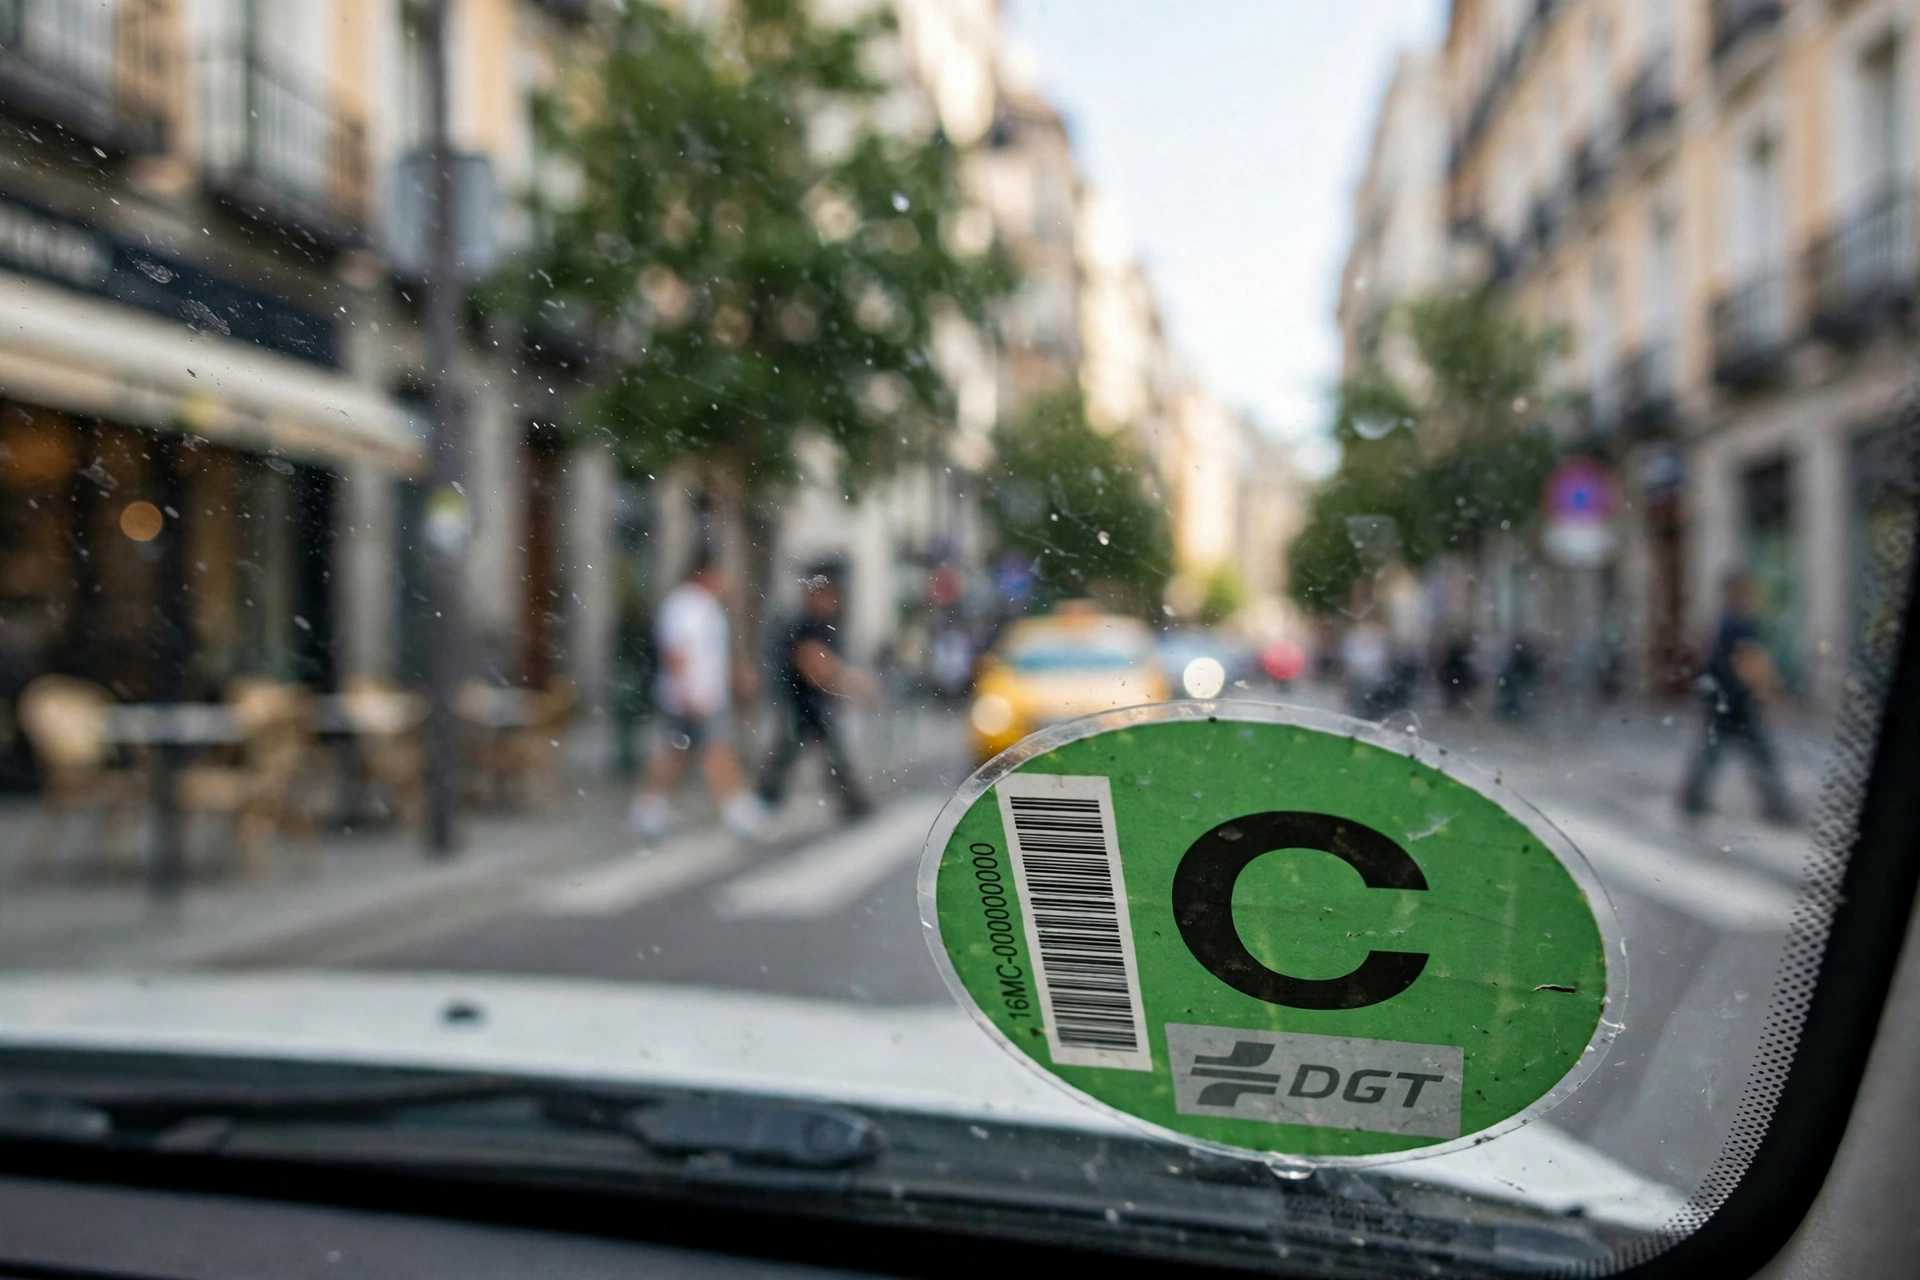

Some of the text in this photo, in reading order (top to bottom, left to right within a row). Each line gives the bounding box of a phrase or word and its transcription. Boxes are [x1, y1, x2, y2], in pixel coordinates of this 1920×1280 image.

[969, 842, 1031, 1020] 16MC-000000000
[1172, 811, 1430, 1010] C
[1287, 1063, 1444, 1108] DGT
